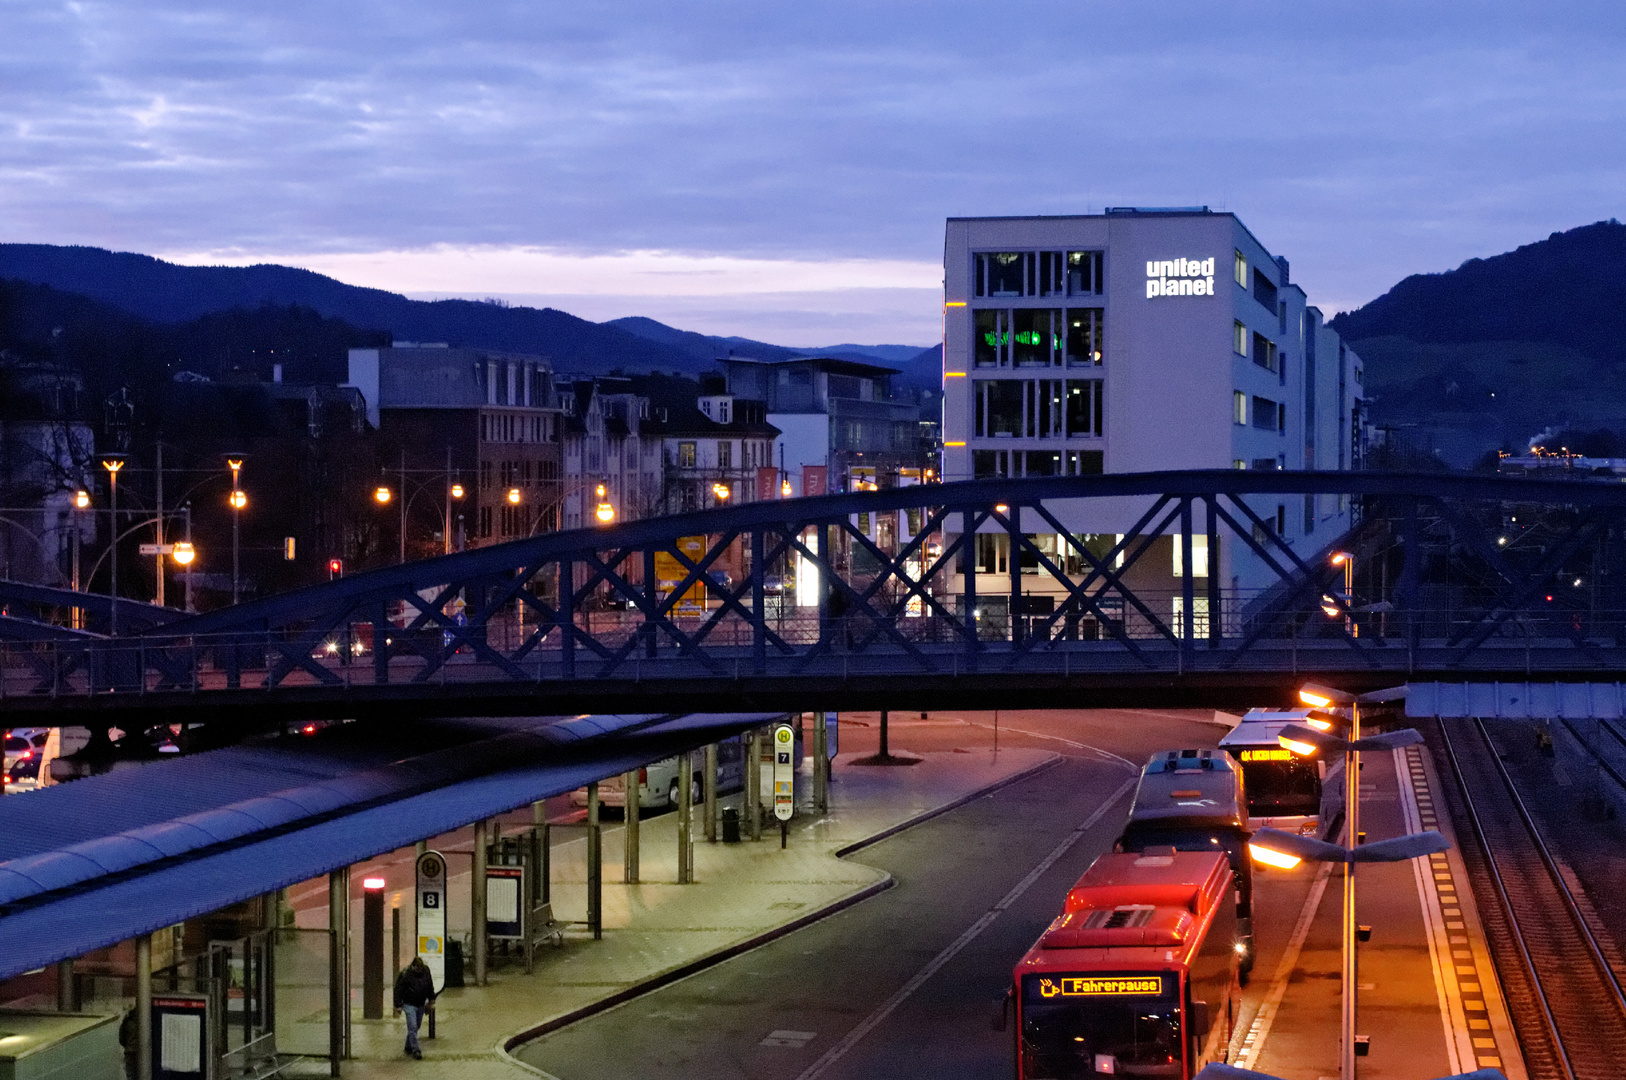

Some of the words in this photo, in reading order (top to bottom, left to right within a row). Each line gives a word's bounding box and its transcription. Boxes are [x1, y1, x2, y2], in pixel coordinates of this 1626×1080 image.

[1146, 257, 1215, 277] united
[1146, 276, 1215, 299] planet
[426, 894, 436, 906] 8
[1073, 980, 1157, 992] Fahrerpause
